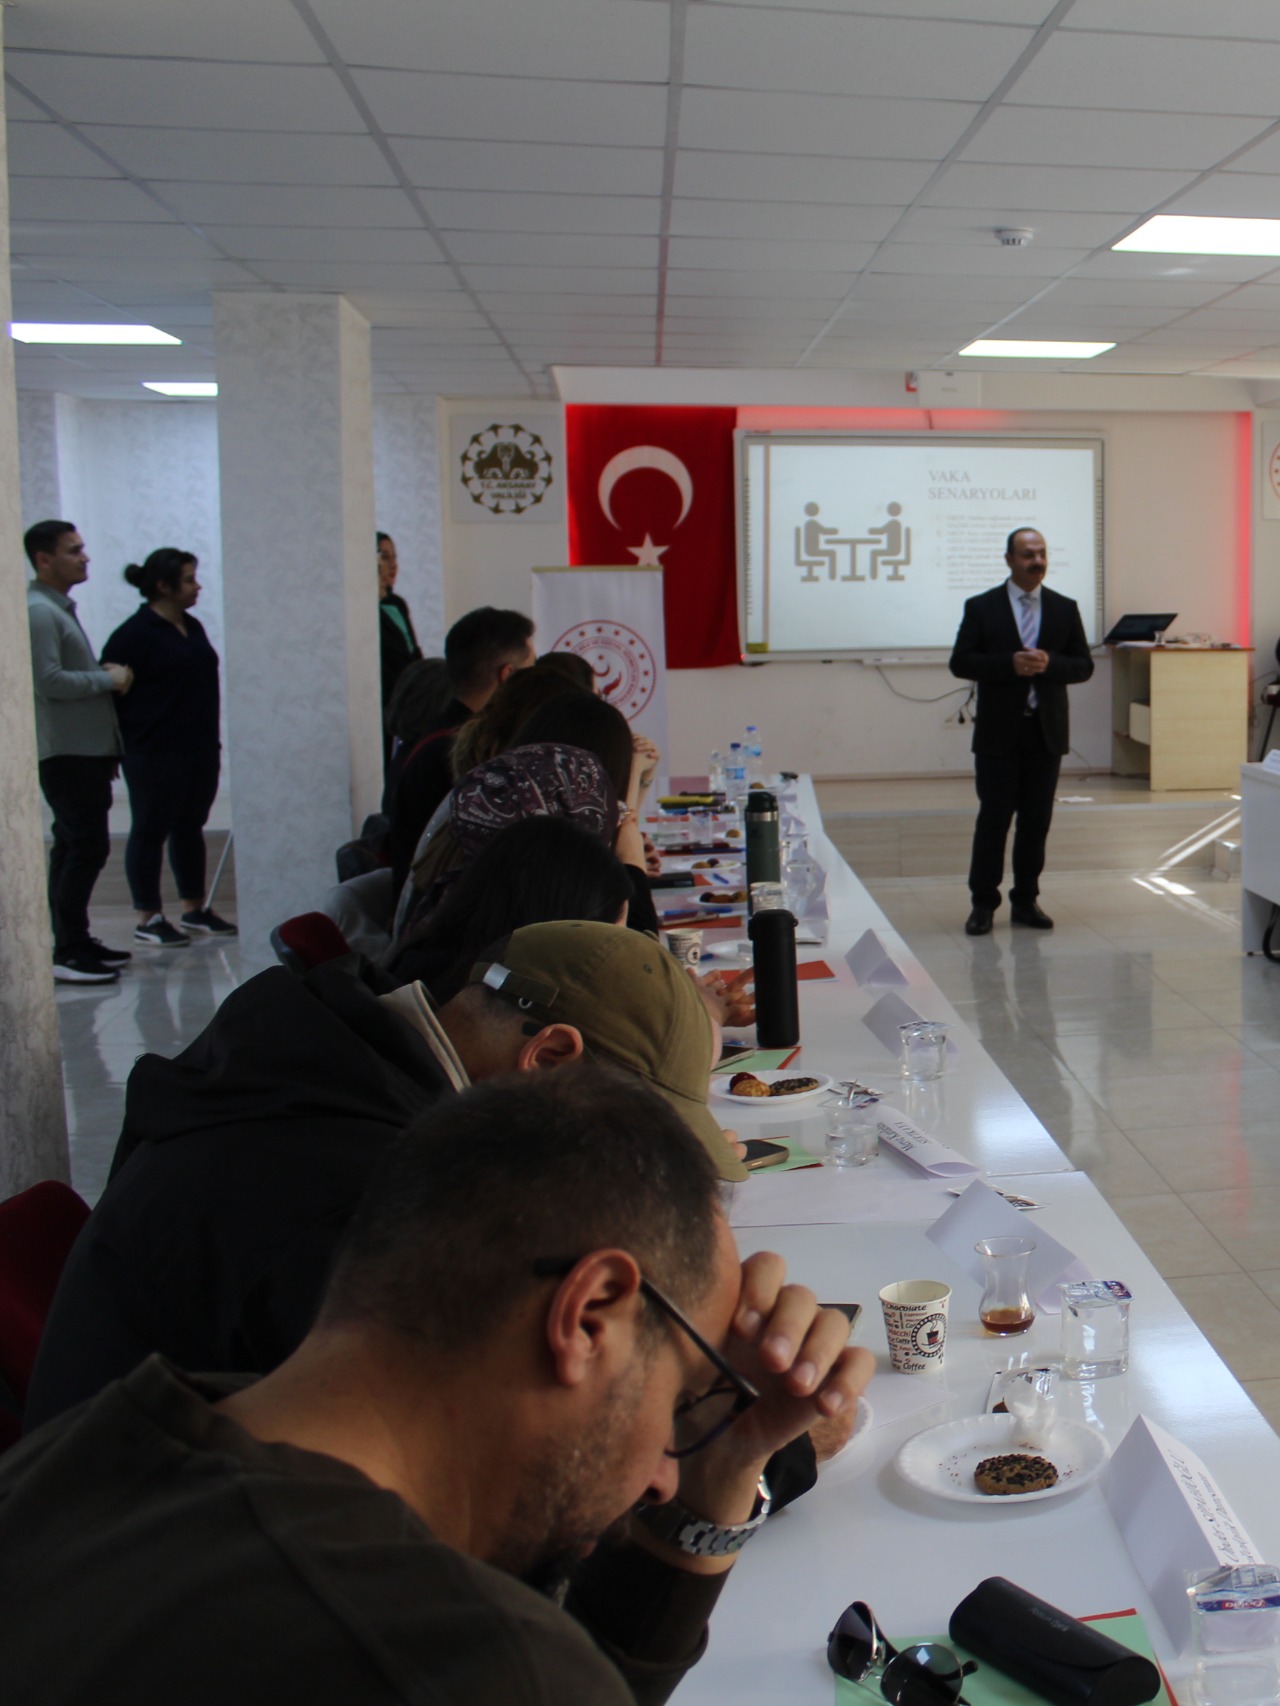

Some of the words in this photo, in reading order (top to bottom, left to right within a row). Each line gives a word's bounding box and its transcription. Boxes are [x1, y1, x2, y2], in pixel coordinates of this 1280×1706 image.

[928, 469, 971, 482] VAKA
[928, 486, 1037, 500] SENARYOLARI
[903, 1363, 926, 1372] Coffee
